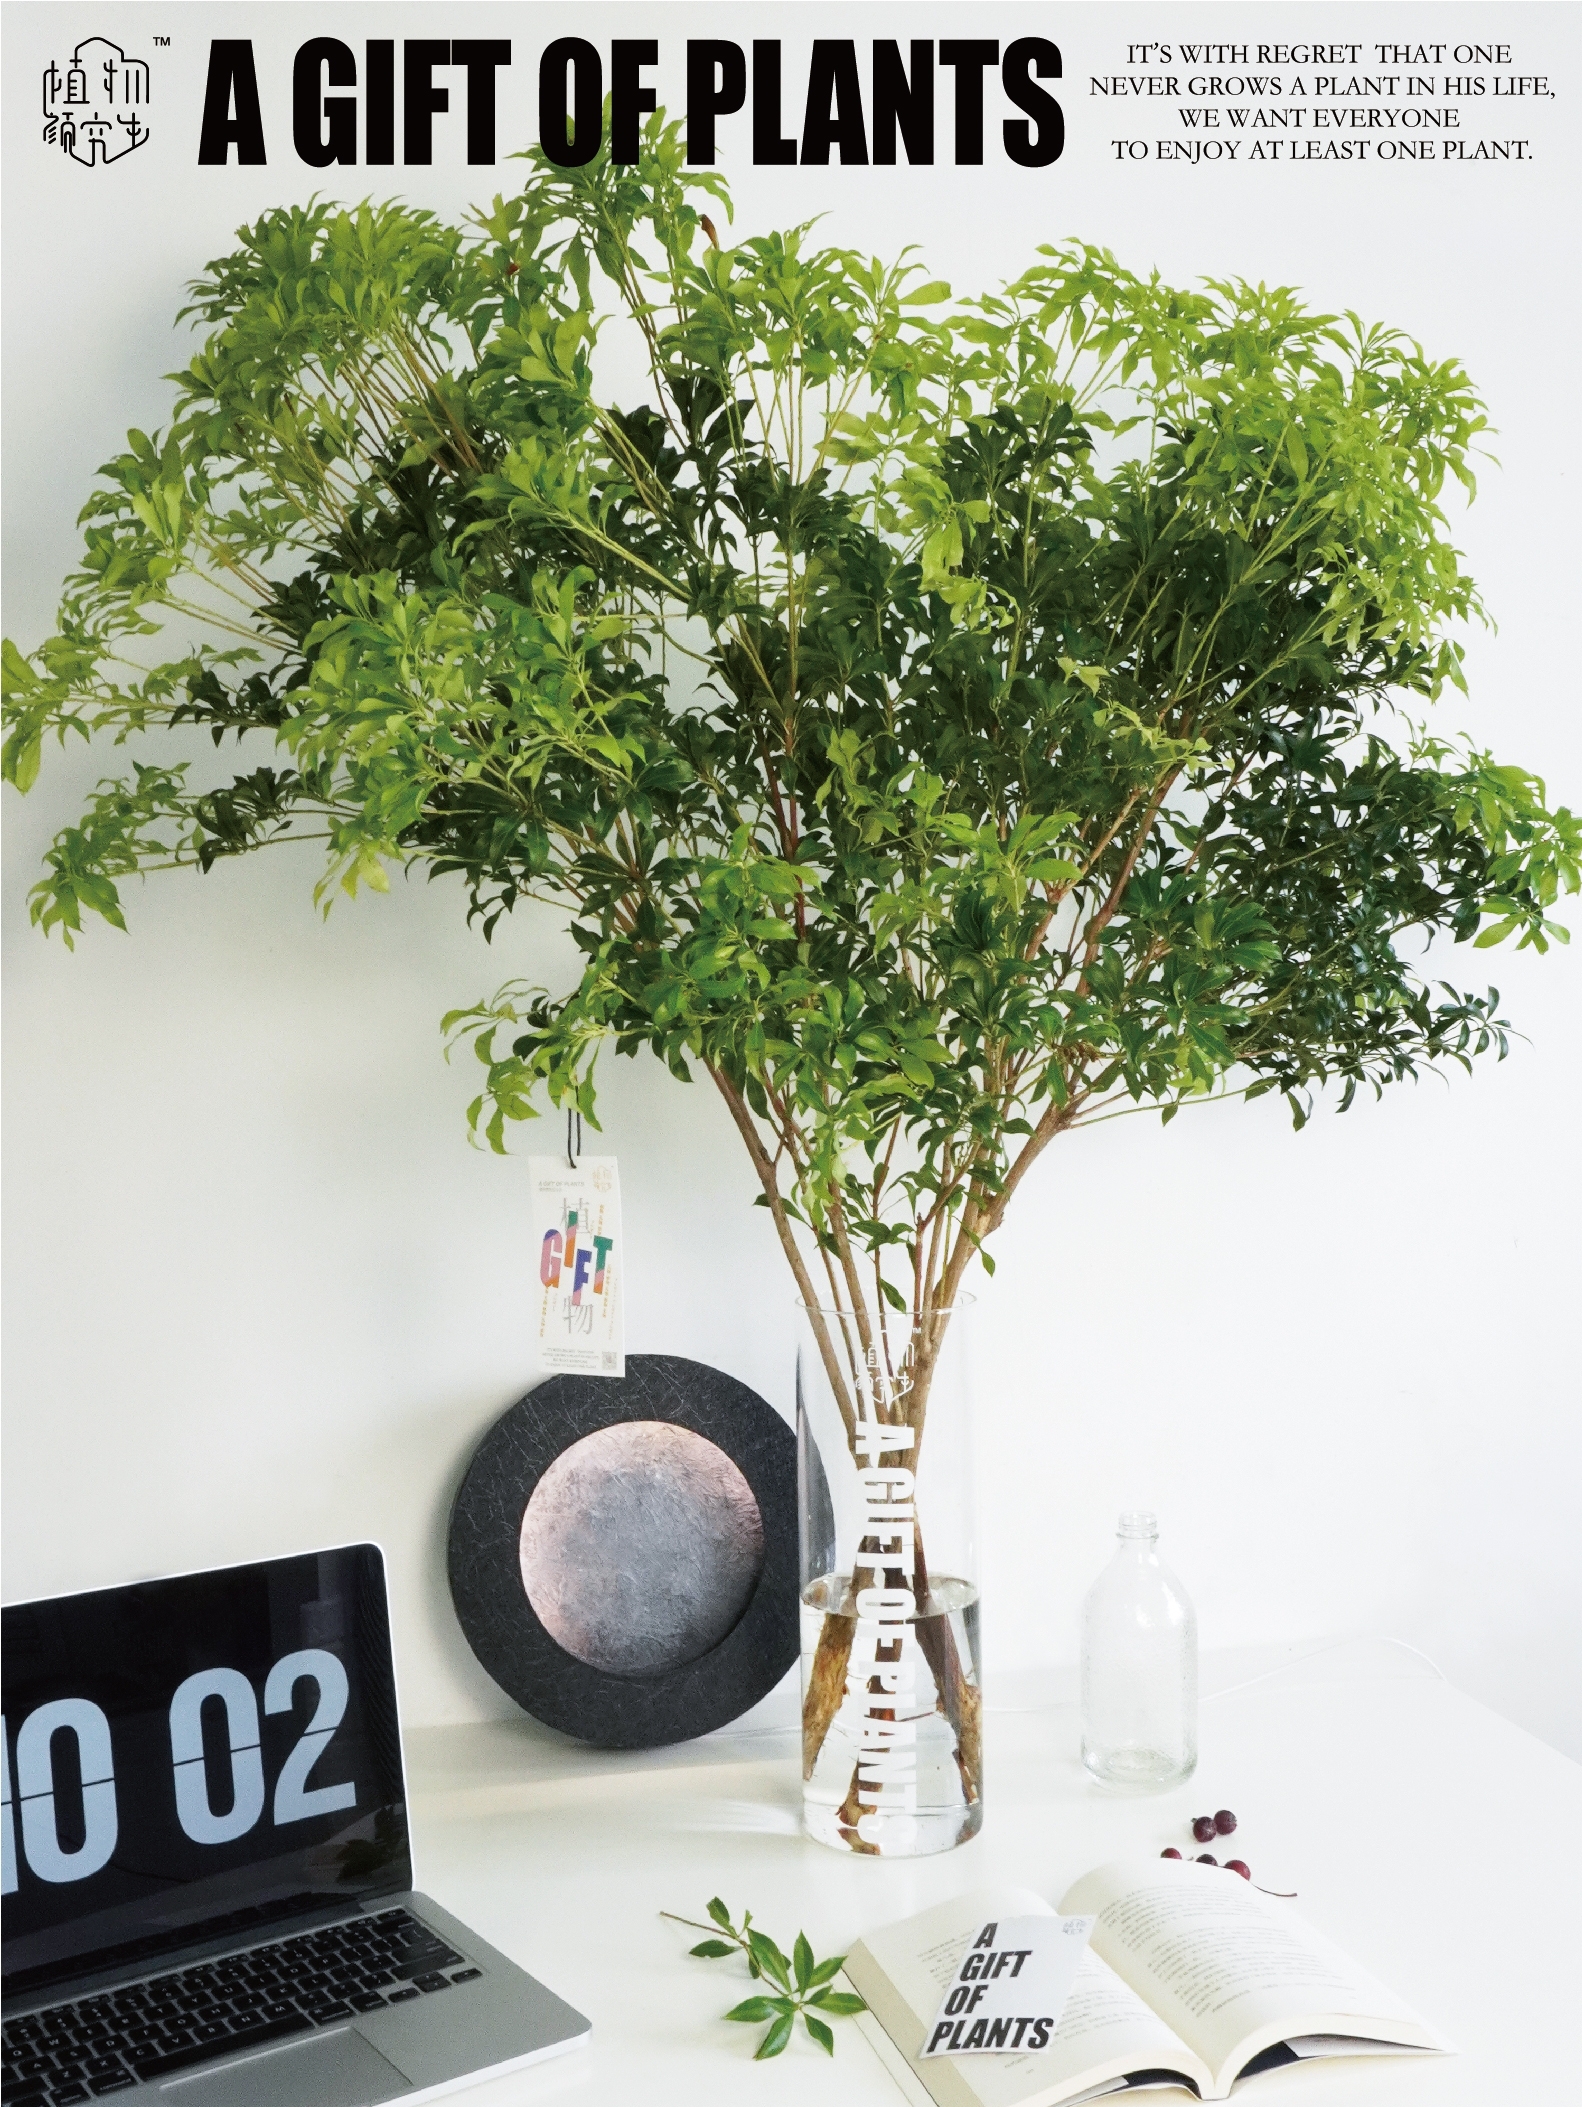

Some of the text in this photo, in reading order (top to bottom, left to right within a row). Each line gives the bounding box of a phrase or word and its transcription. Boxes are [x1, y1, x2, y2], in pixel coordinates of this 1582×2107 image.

[856, 1420, 915, 1455] A
[856, 1467, 915, 1576] GIFT
[169, 1648, 357, 1845] 02
[972, 1922, 998, 1949] A
[959, 1950, 1033, 1982] GIFT
[944, 1984, 989, 2017] OF
[926, 2017, 1054, 2053] PLANTS
